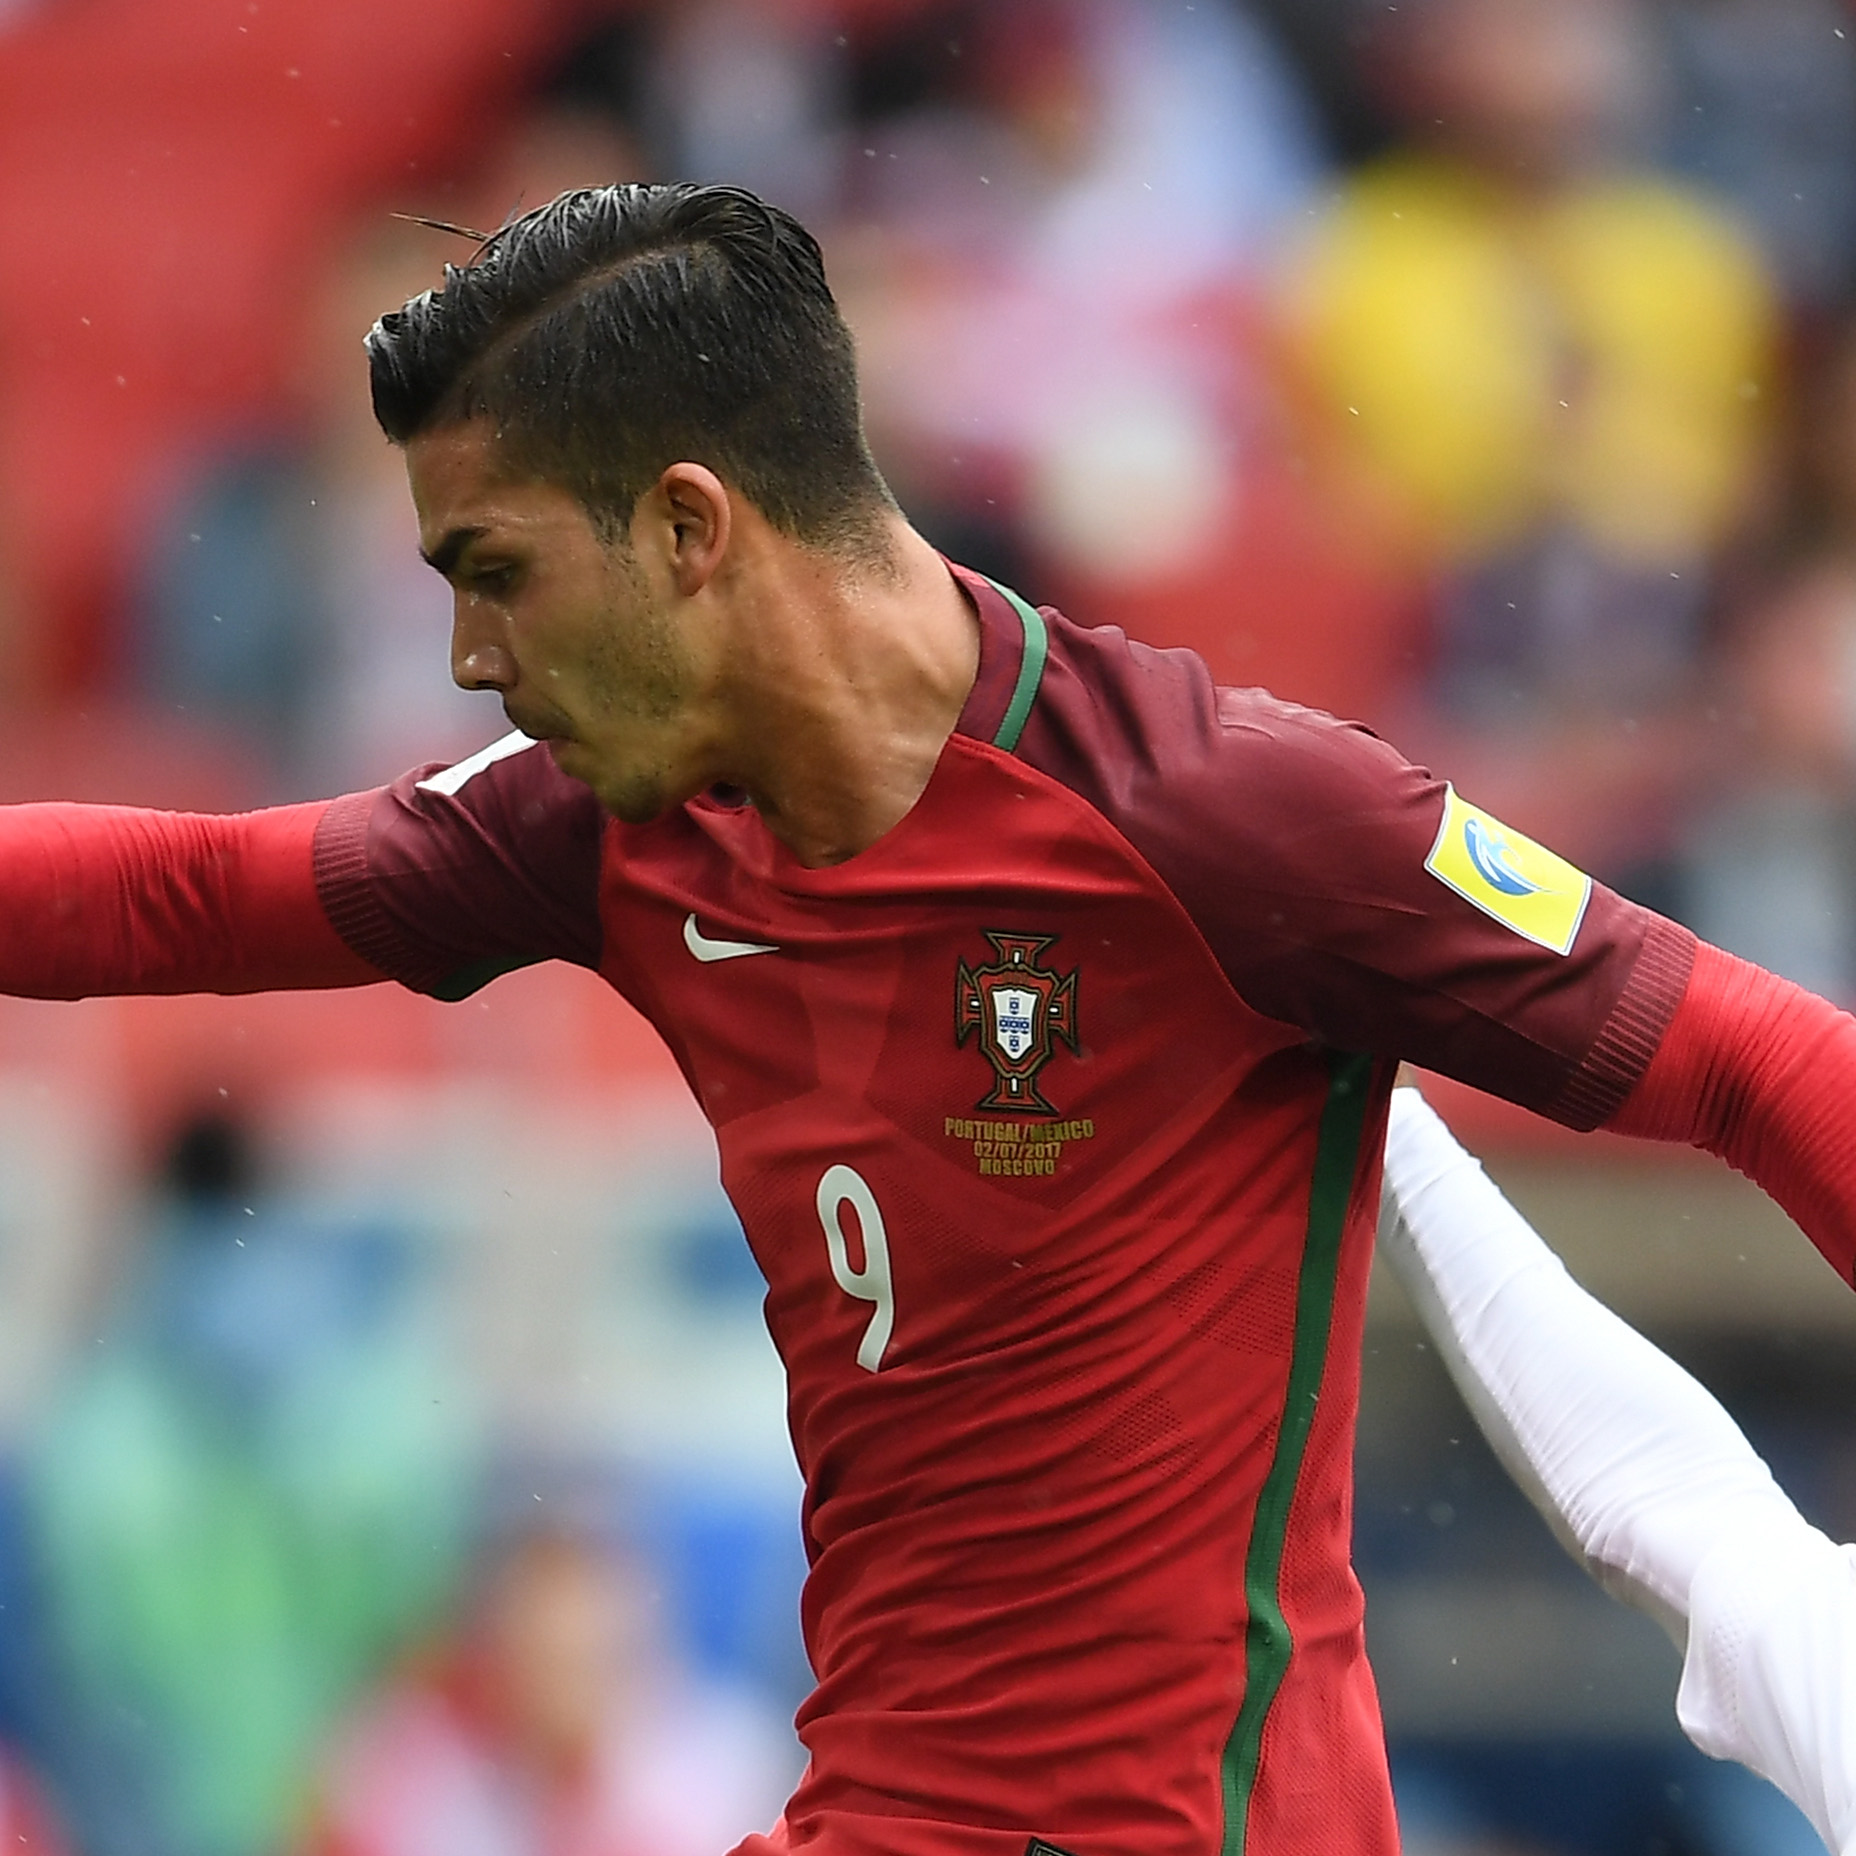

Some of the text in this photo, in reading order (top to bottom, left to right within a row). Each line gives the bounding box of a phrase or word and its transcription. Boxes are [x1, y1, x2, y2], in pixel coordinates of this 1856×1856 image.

[944, 1117, 1094, 1142] PORTUGAL/MEXICO
[973, 1141, 1062, 1159] 02/07/2017
[979, 1158, 1055, 1176] MOSCOVO
[816, 1164, 895, 1374] 9
